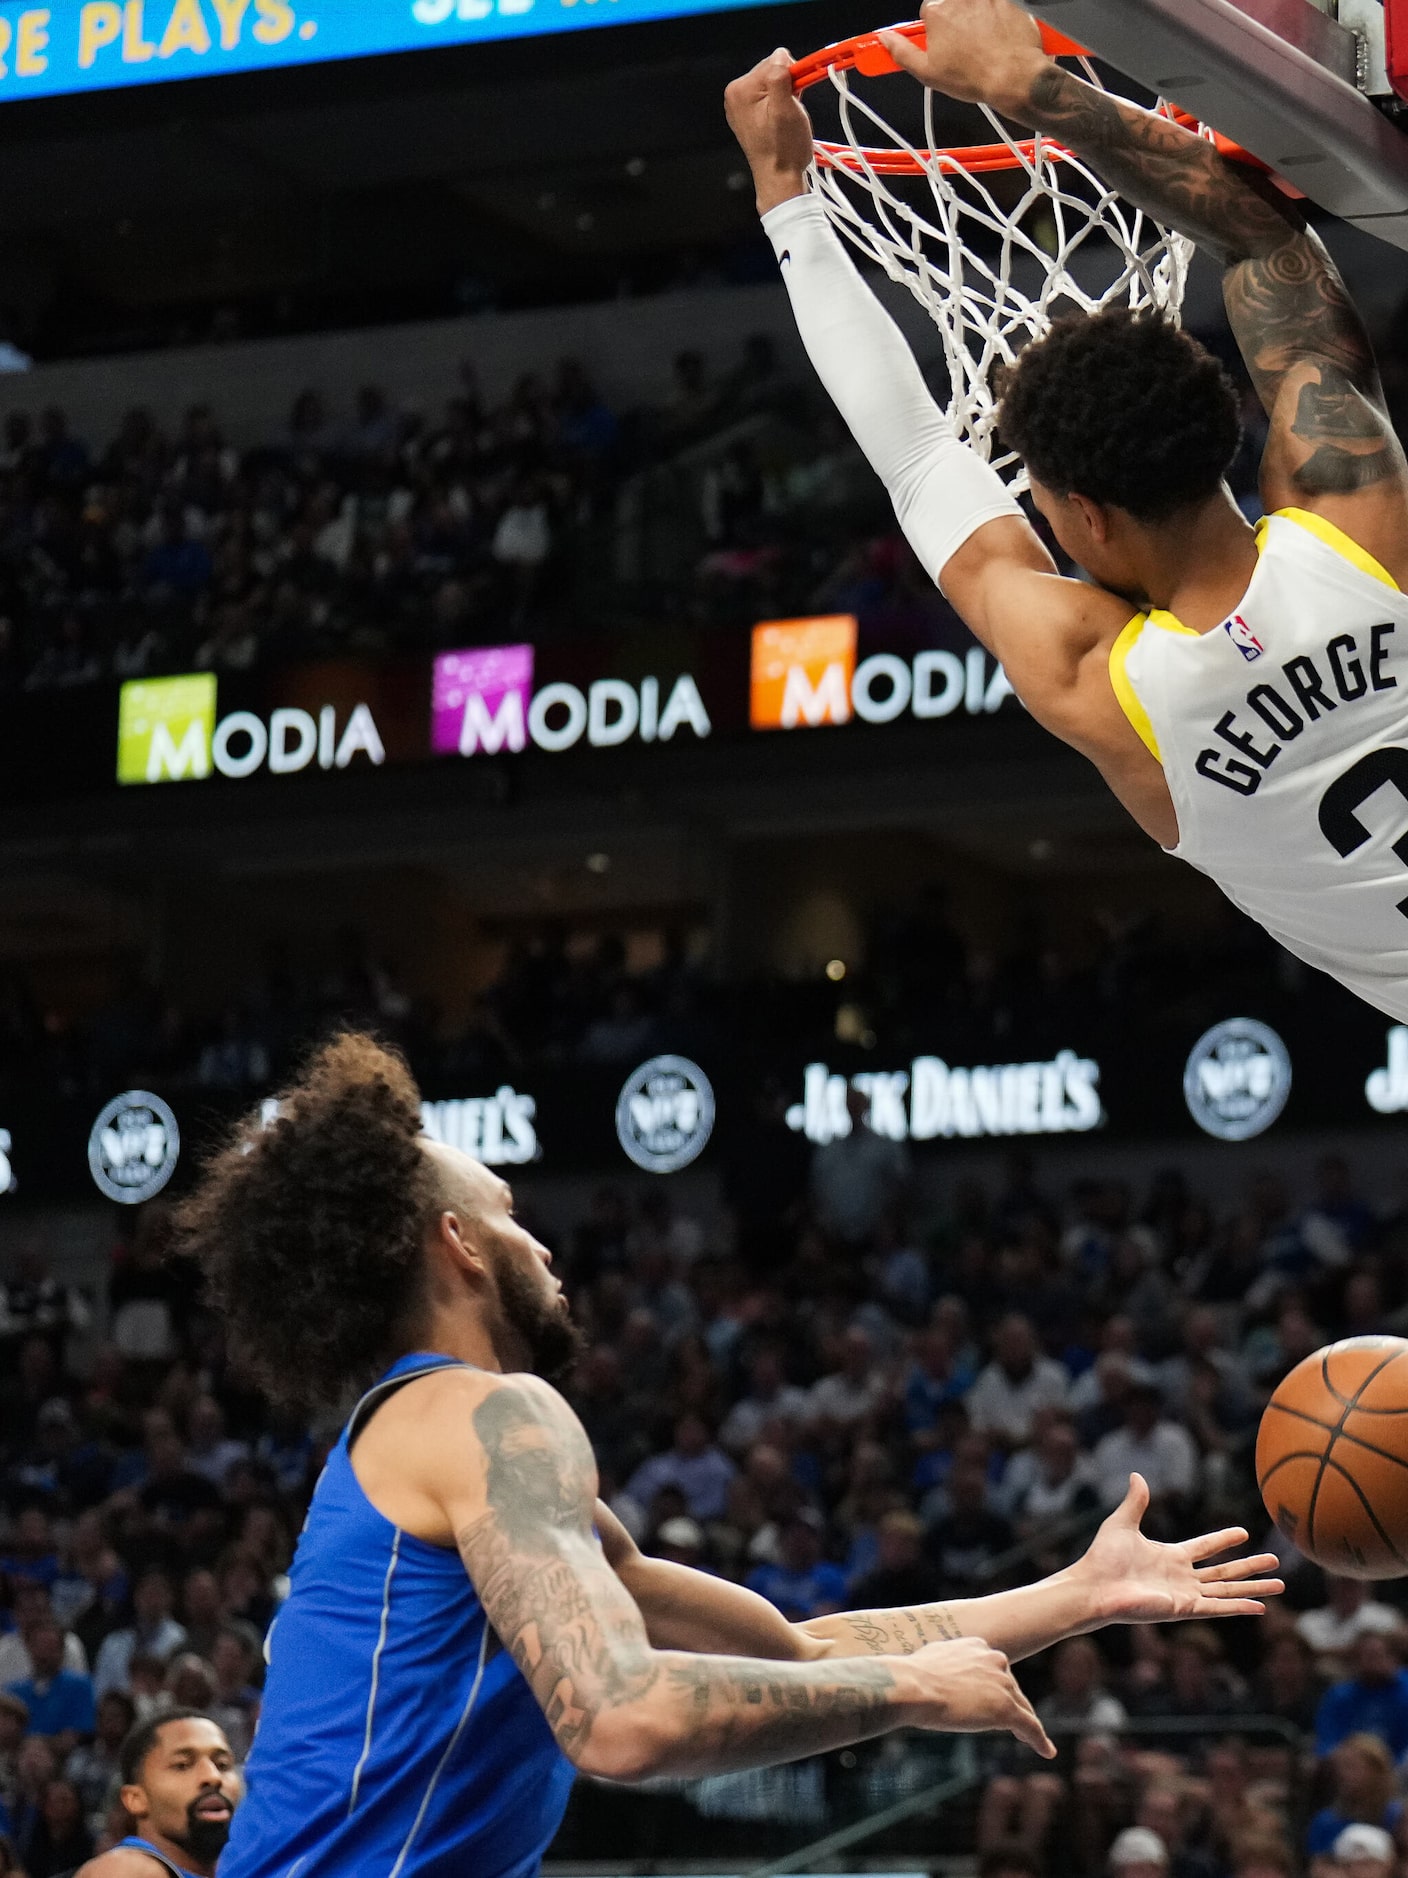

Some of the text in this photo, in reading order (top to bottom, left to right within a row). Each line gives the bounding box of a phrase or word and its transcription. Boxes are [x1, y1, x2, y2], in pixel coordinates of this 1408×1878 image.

[0, 0, 318, 79] E PLAYS.
[145, 701, 386, 784] MODIA
[458, 673, 711, 757] MODIA
[1195, 622, 1398, 797] GEORGE
